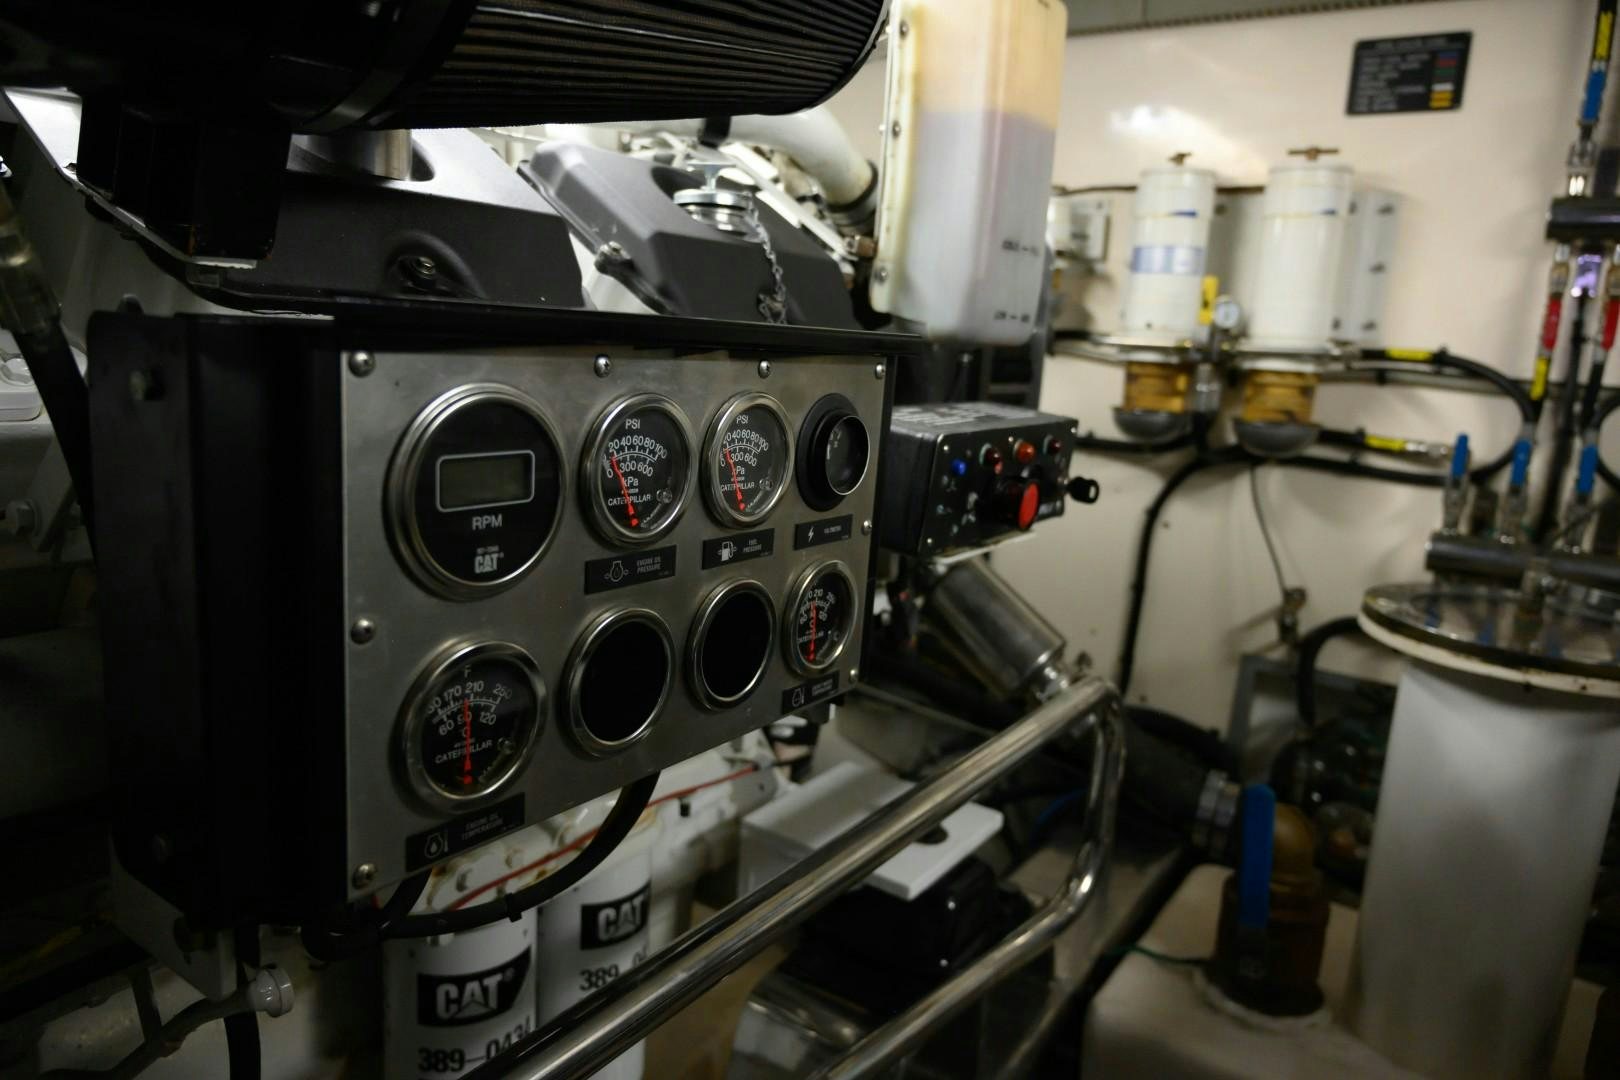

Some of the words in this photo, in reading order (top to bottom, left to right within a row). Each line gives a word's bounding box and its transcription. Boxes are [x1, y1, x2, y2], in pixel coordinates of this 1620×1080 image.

[625, 419, 641, 430] PSI
[736, 415, 749, 425] PSI
[732, 430, 741, 439] 40
[741, 429, 751, 439] 60
[750, 431, 760, 442] 80
[608, 439, 620, 453] 20
[620, 435, 632, 446] 40
[632, 434, 644, 446] 60
[643, 437, 655, 450] 80
[655, 443, 667, 459] 100
[606, 468, 614, 478] 0
[619, 460, 636, 473] 300
[637, 462, 654, 477] 600
[744, 453, 757, 467] 600
[472, 513, 503, 530] RPM
[474, 552, 499, 574] CAT
[444, 685, 462, 701] 170
[465, 680, 484, 693] 210
[493, 683, 512, 699] 250
[439, 720, 455, 735] 60
[480, 711, 497, 725] 120
[435, 740, 492, 763] CATEILLAR
[598, 897, 642, 940] CAT
[436, 973, 500, 1020] CAT
